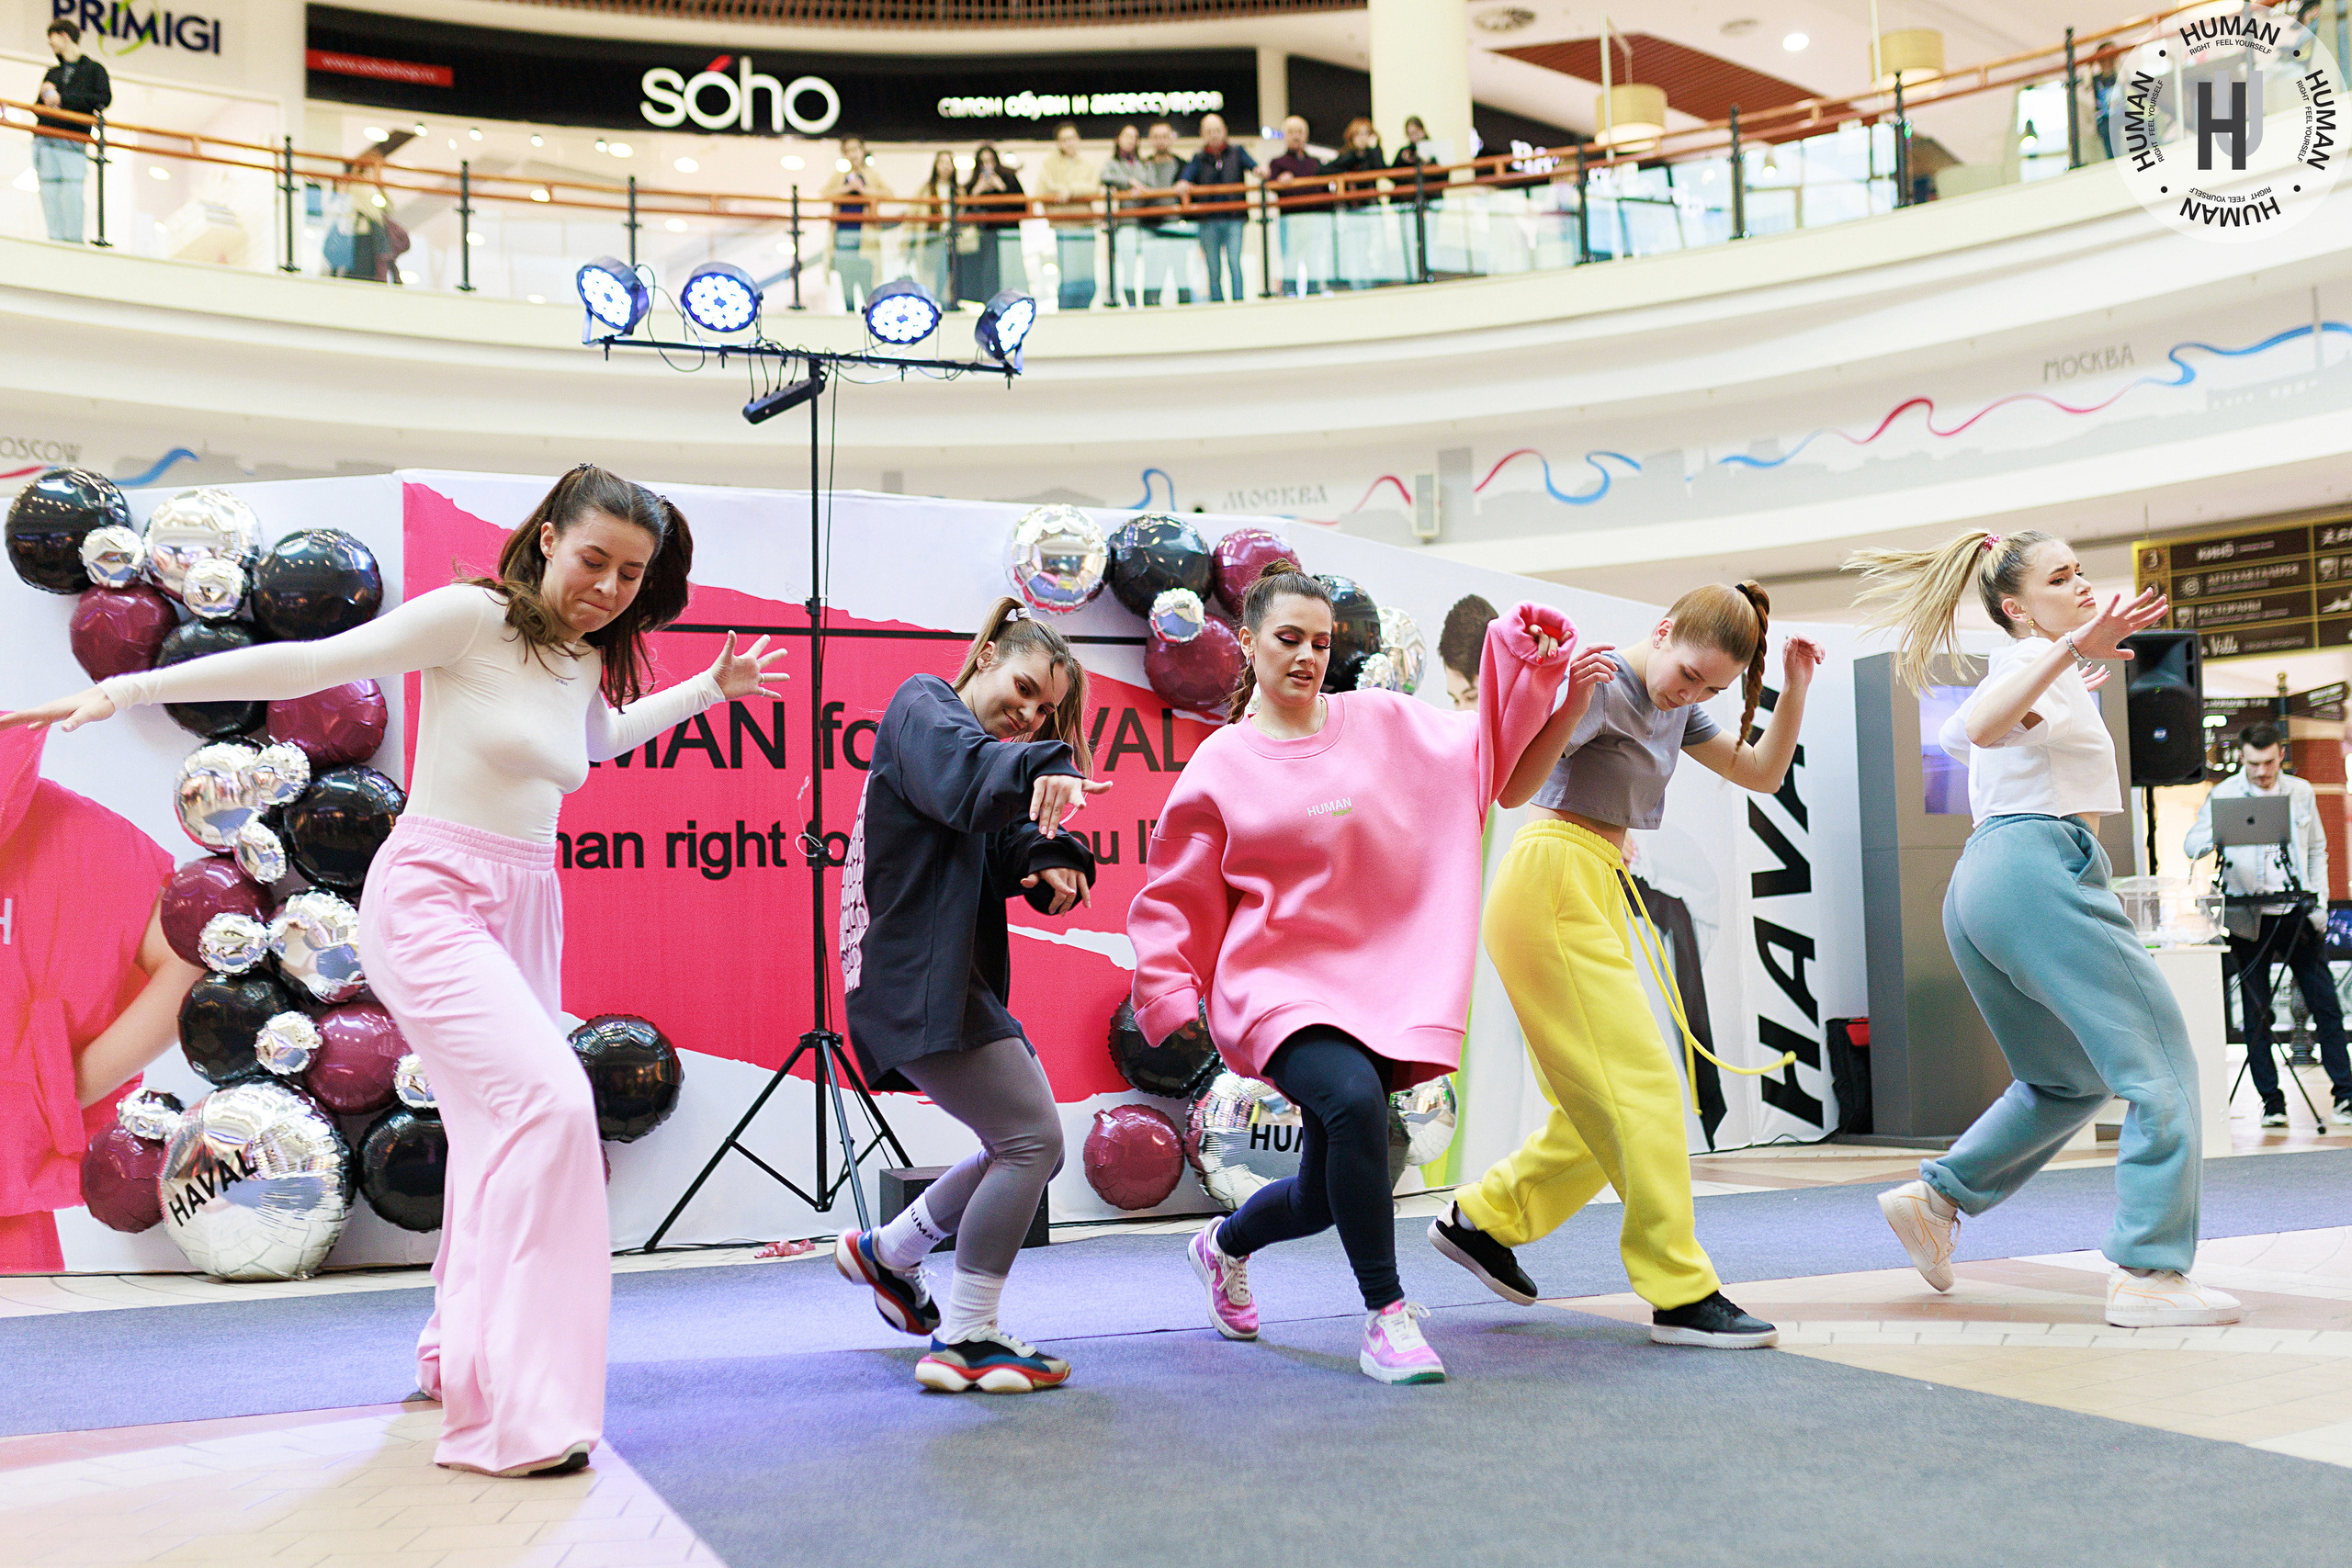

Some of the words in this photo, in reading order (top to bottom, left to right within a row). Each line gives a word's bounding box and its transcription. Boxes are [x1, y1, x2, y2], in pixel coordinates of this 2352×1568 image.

[52, 0, 220, 55] PRIMIGI
[937, 96, 1003, 118] салон
[1004, 90, 1070, 120] обуви
[1071, 94, 1089, 116] и
[1090, 91, 1224, 118] аксессуаров
[2042, 344, 2135, 383] МОСКВА
[1222, 484, 1329, 511] МОСКВА
[820, 701, 879, 771] fo
[1306, 797, 1352, 817] HUMAN
[1332, 807, 1352, 817] RIGHT
[666, 820, 787, 880] right
[169, 1149, 257, 1227] HAVAL
